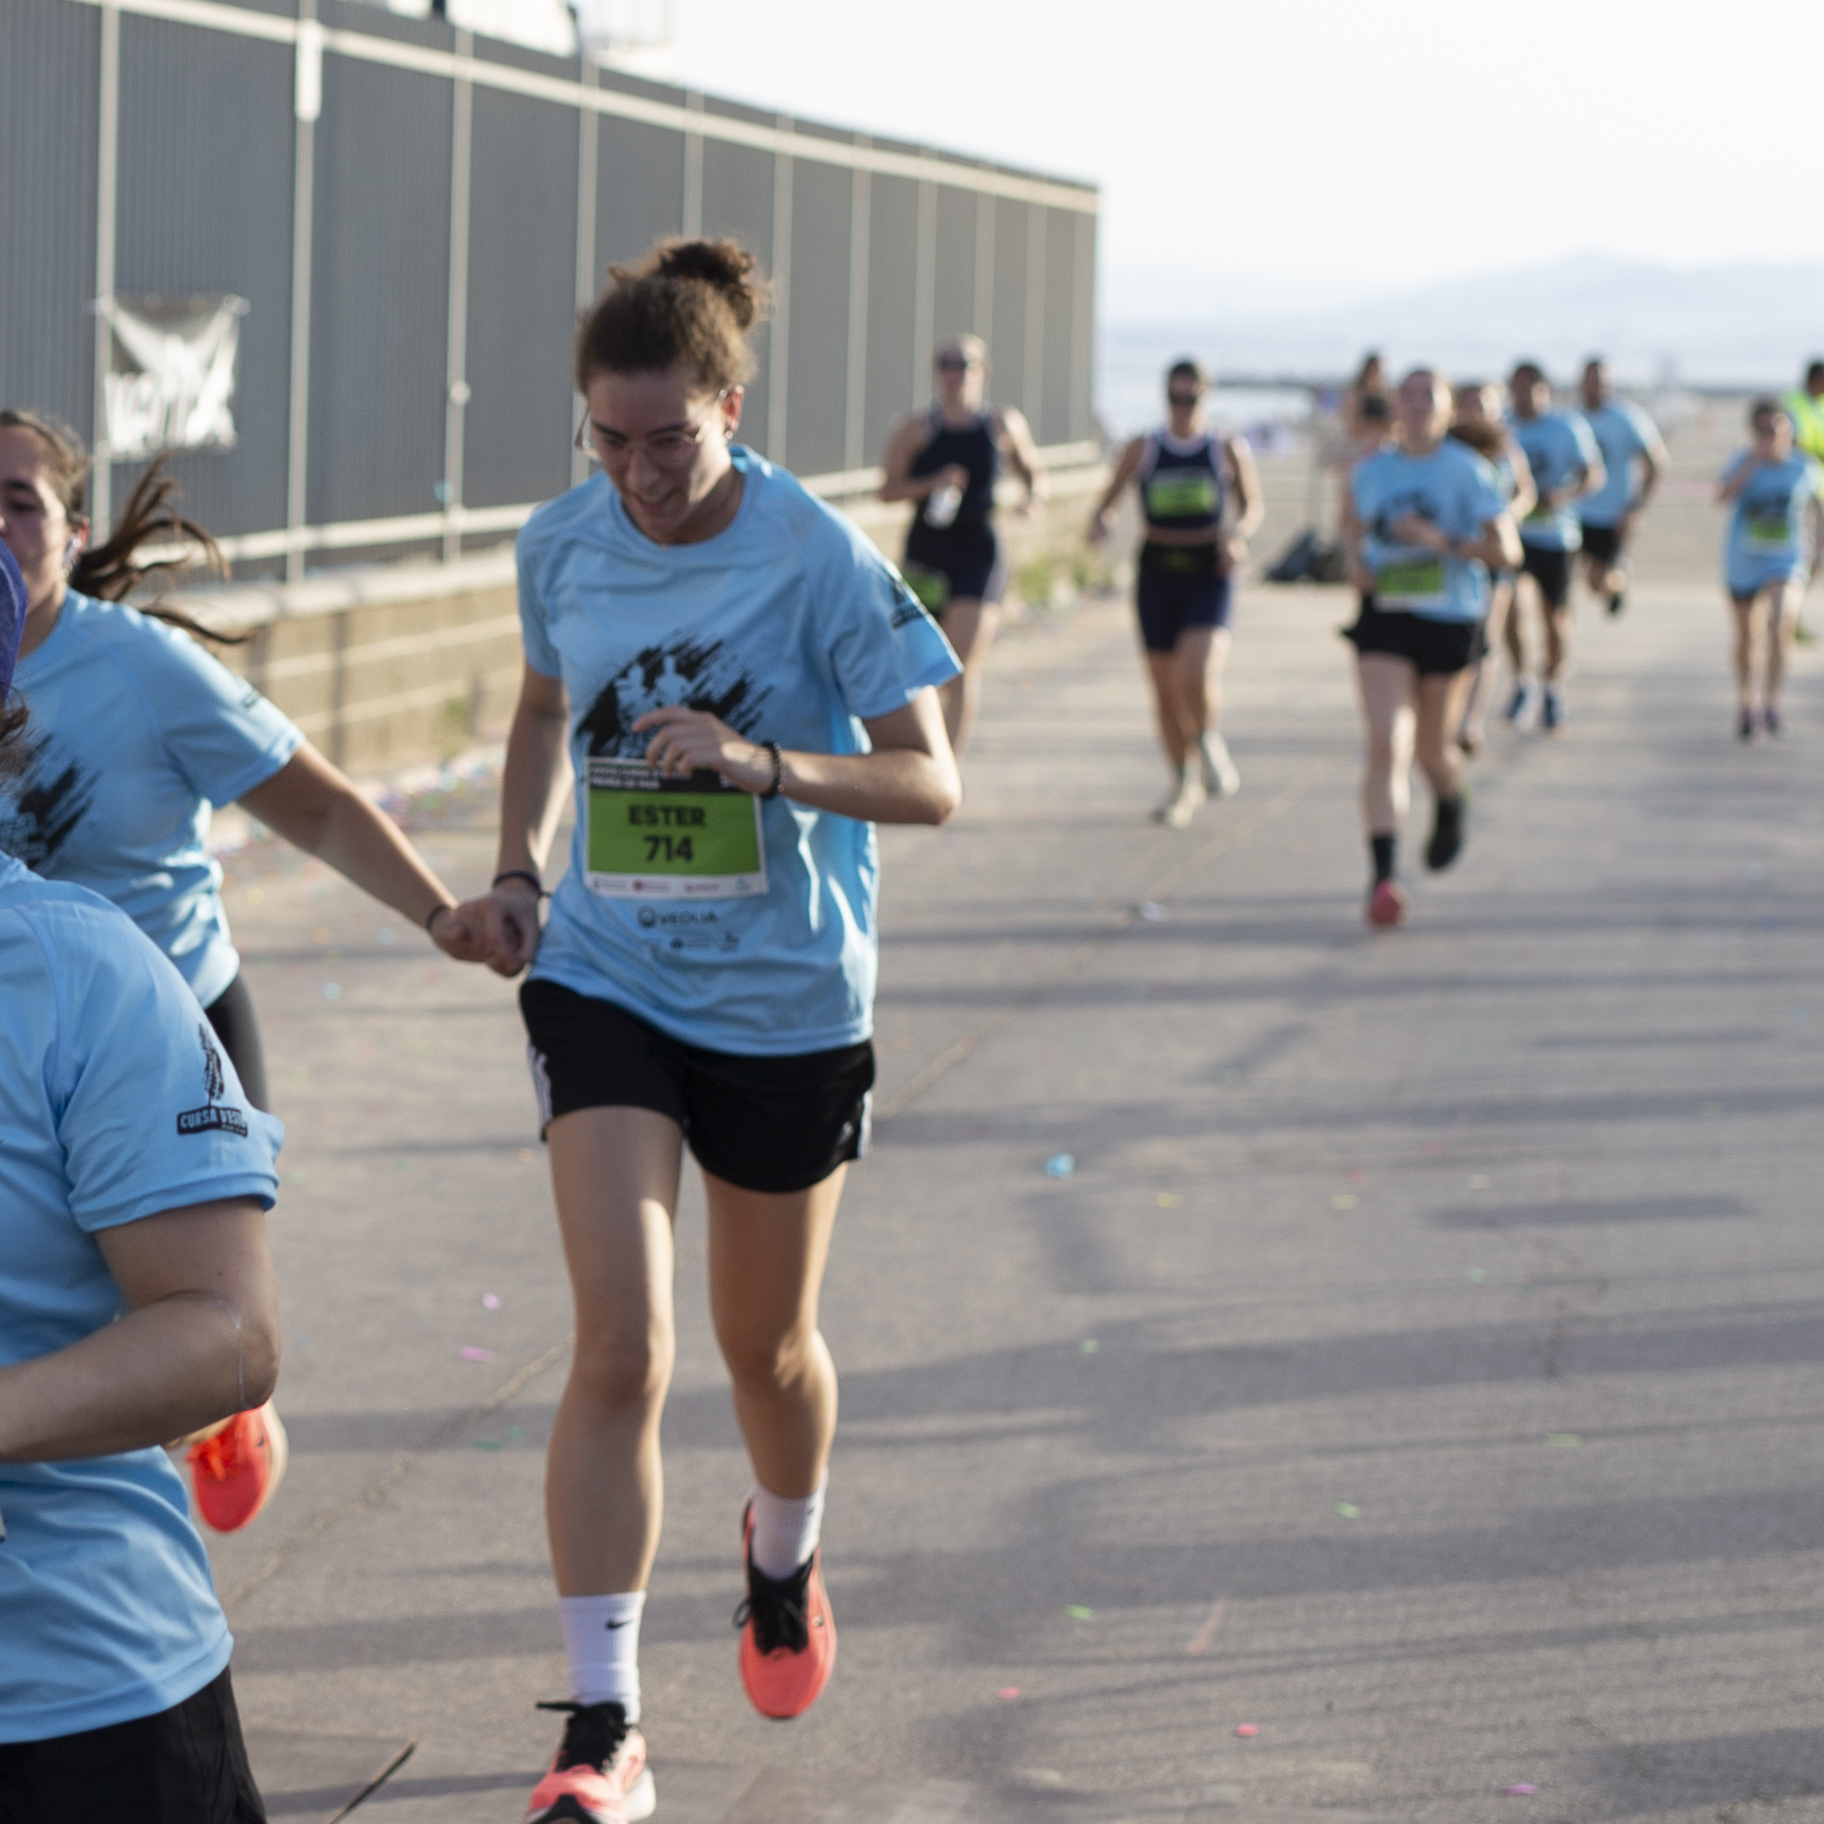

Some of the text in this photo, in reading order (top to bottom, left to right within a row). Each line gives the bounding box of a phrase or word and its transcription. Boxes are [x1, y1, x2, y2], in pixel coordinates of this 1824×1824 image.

[627, 804, 706, 827] ESTER
[643, 835, 694, 863] 714
[180, 1108, 218, 1129] CURSA
